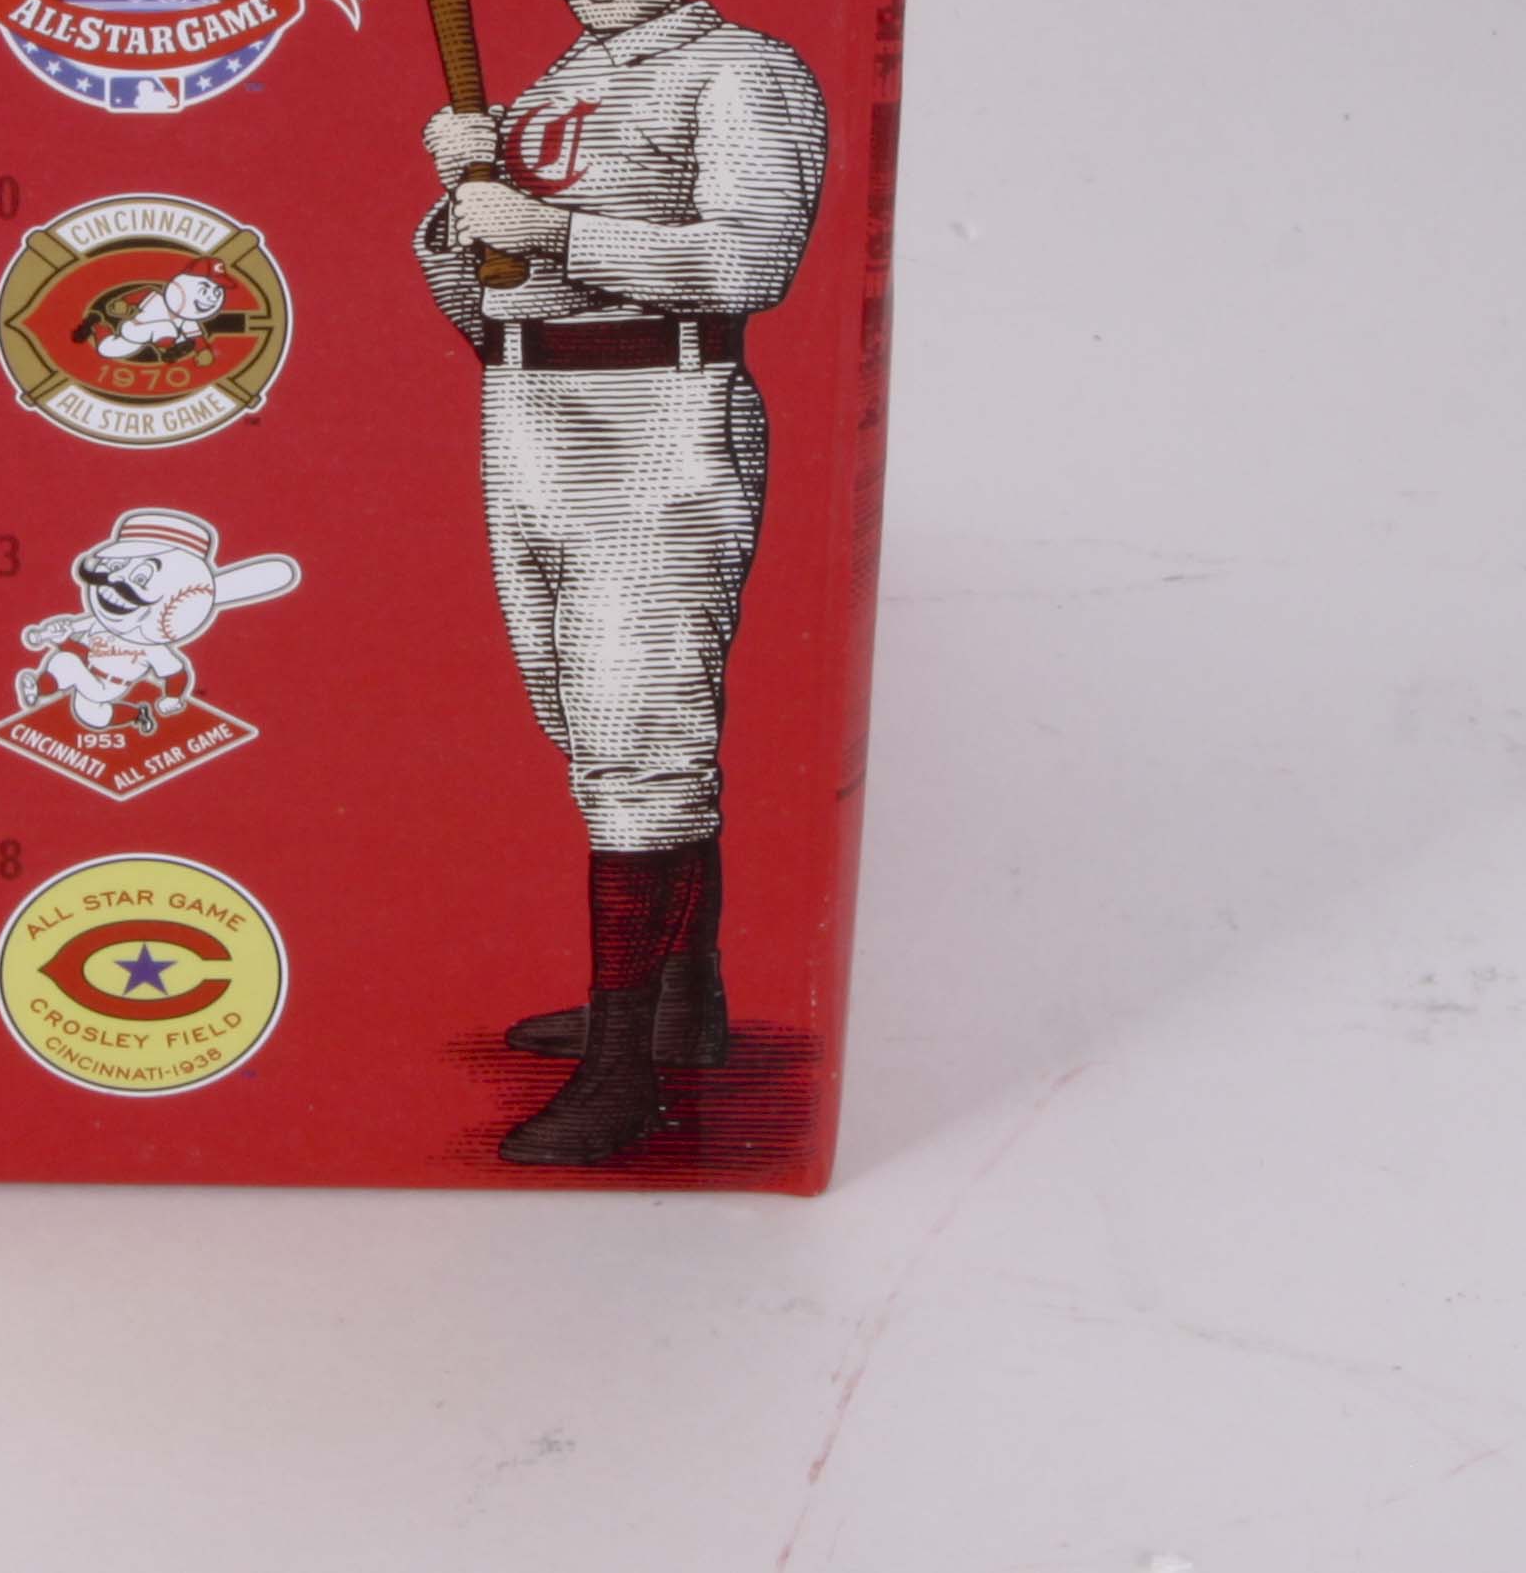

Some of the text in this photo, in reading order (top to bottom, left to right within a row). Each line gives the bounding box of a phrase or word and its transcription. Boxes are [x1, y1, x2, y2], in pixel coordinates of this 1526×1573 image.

[70, 209, 217, 247] CINCINNATI
[97, 364, 191, 391] 1970
[57, 392, 224, 434] ALL STAR GAME
[10, 723, 107, 778] CINCINNATI
[77, 734, 126, 749] 1953
[113, 723, 234, 790] ALL STAR GAME
[27, 890, 247, 939] ALL STAR GAME
[30, 998, 242, 1048] CROSLEY FIELD
